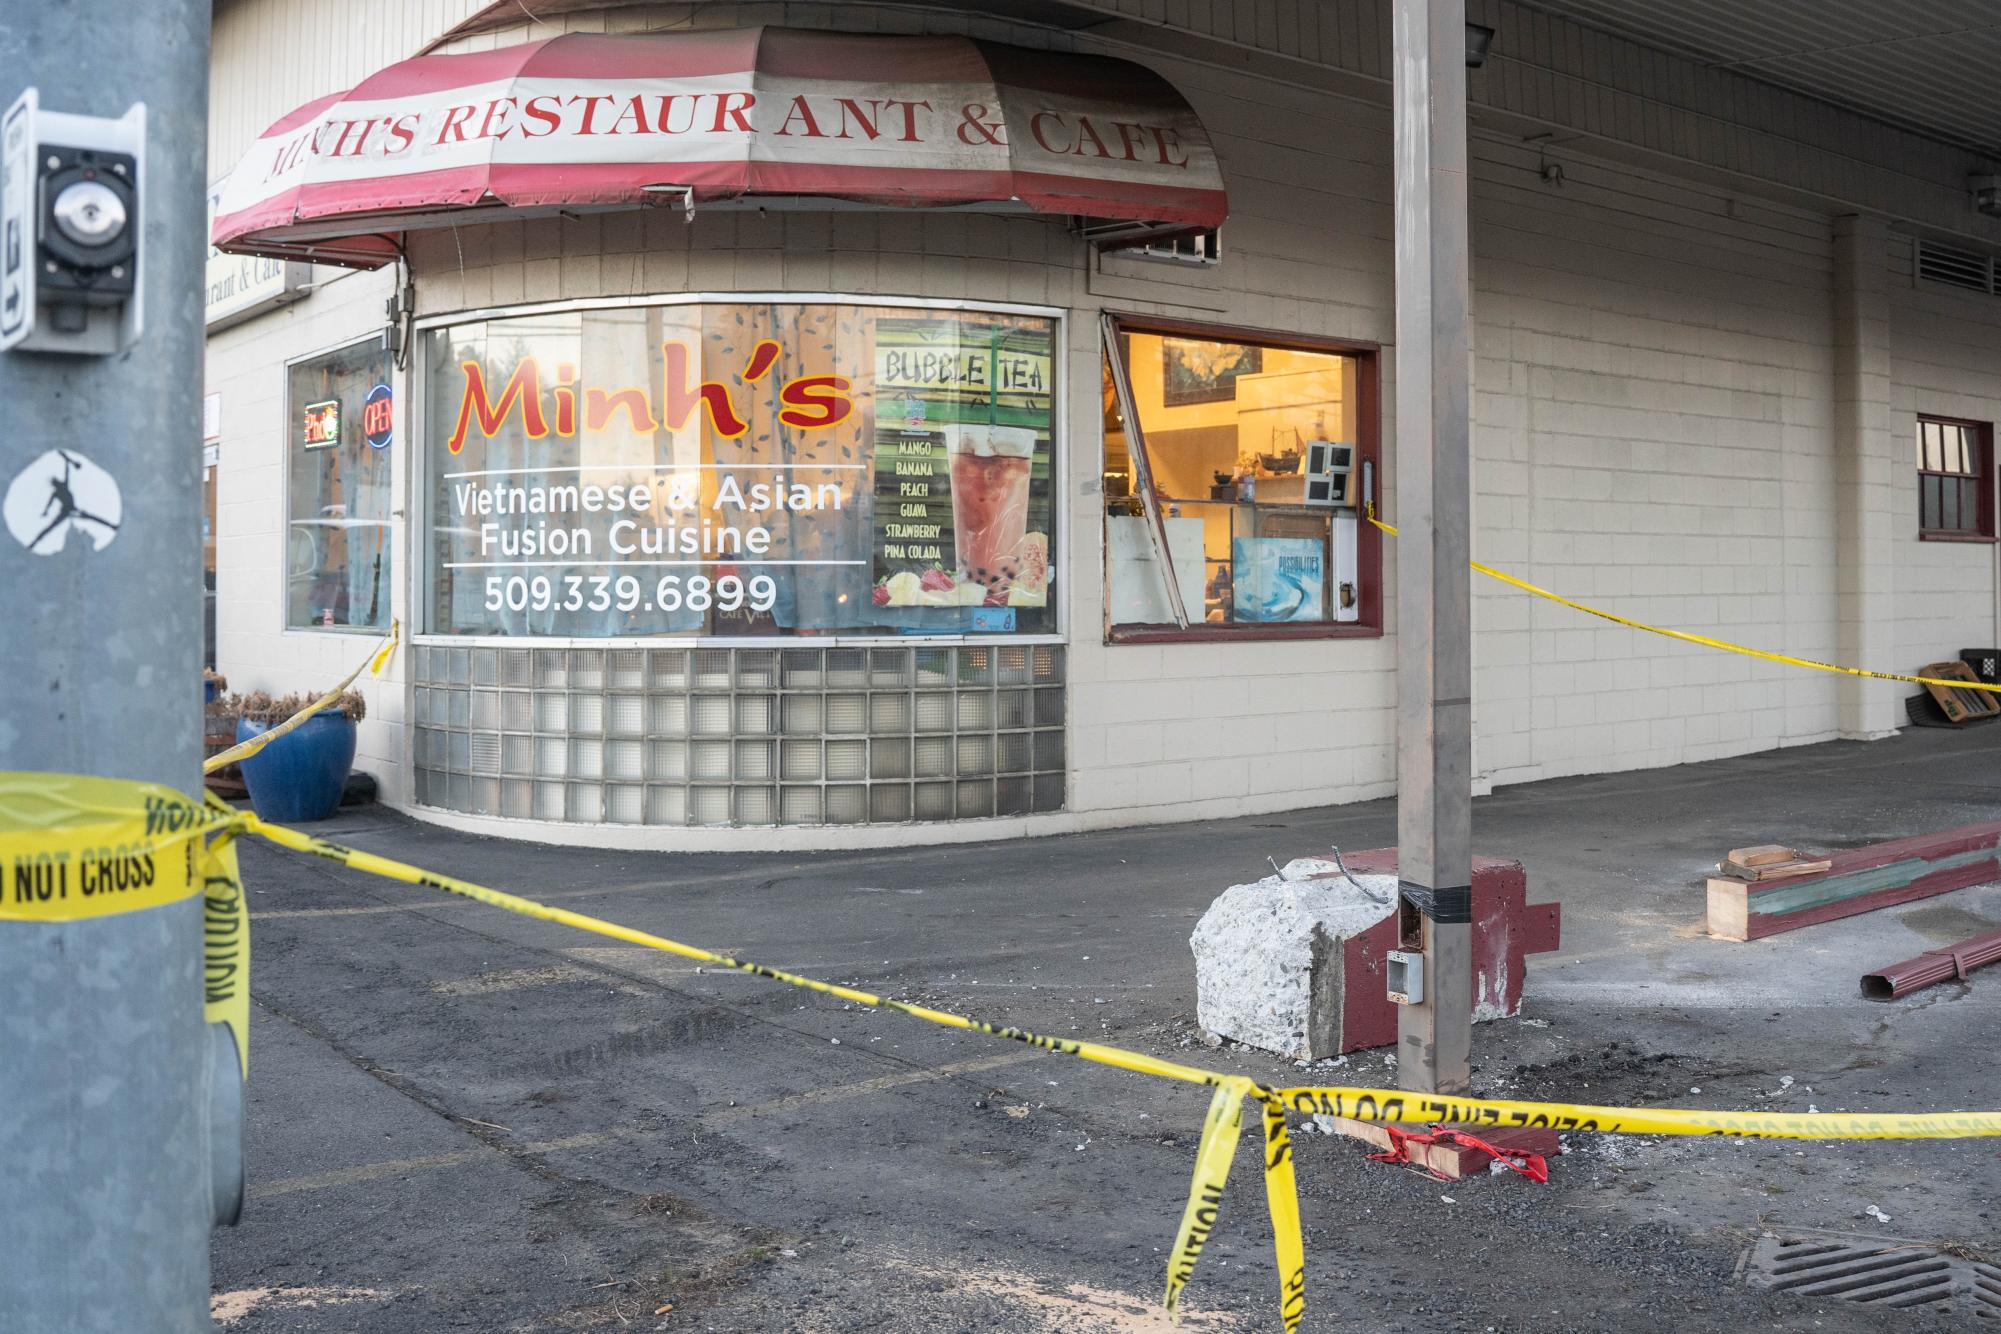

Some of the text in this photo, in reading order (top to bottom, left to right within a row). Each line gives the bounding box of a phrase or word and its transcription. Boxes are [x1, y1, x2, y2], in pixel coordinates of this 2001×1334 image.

[957, 103, 1009, 145] &
[1030, 111, 1190, 169] CAFE
[886, 350, 1042, 391] BUBBLE TEA
[447, 338, 857, 456] Minh's
[364, 399, 393, 436] OPEN
[899, 441, 932, 455] MANGO
[896, 462, 933, 476] BANANA
[455, 475, 842, 517] Vietnamese & Asian
[900, 483, 928, 497] PEACH
[900, 504, 927, 517] GUAVA
[481, 519, 771, 557] Fusion Cuisine
[885, 524, 941, 539] STRAWBERRY
[884, 545, 941, 560] PINA COLADA
[485, 575, 778, 612] 509.339.6899
[15, 852, 69, 904] NOT
[81, 841, 155, 896] CROSS
